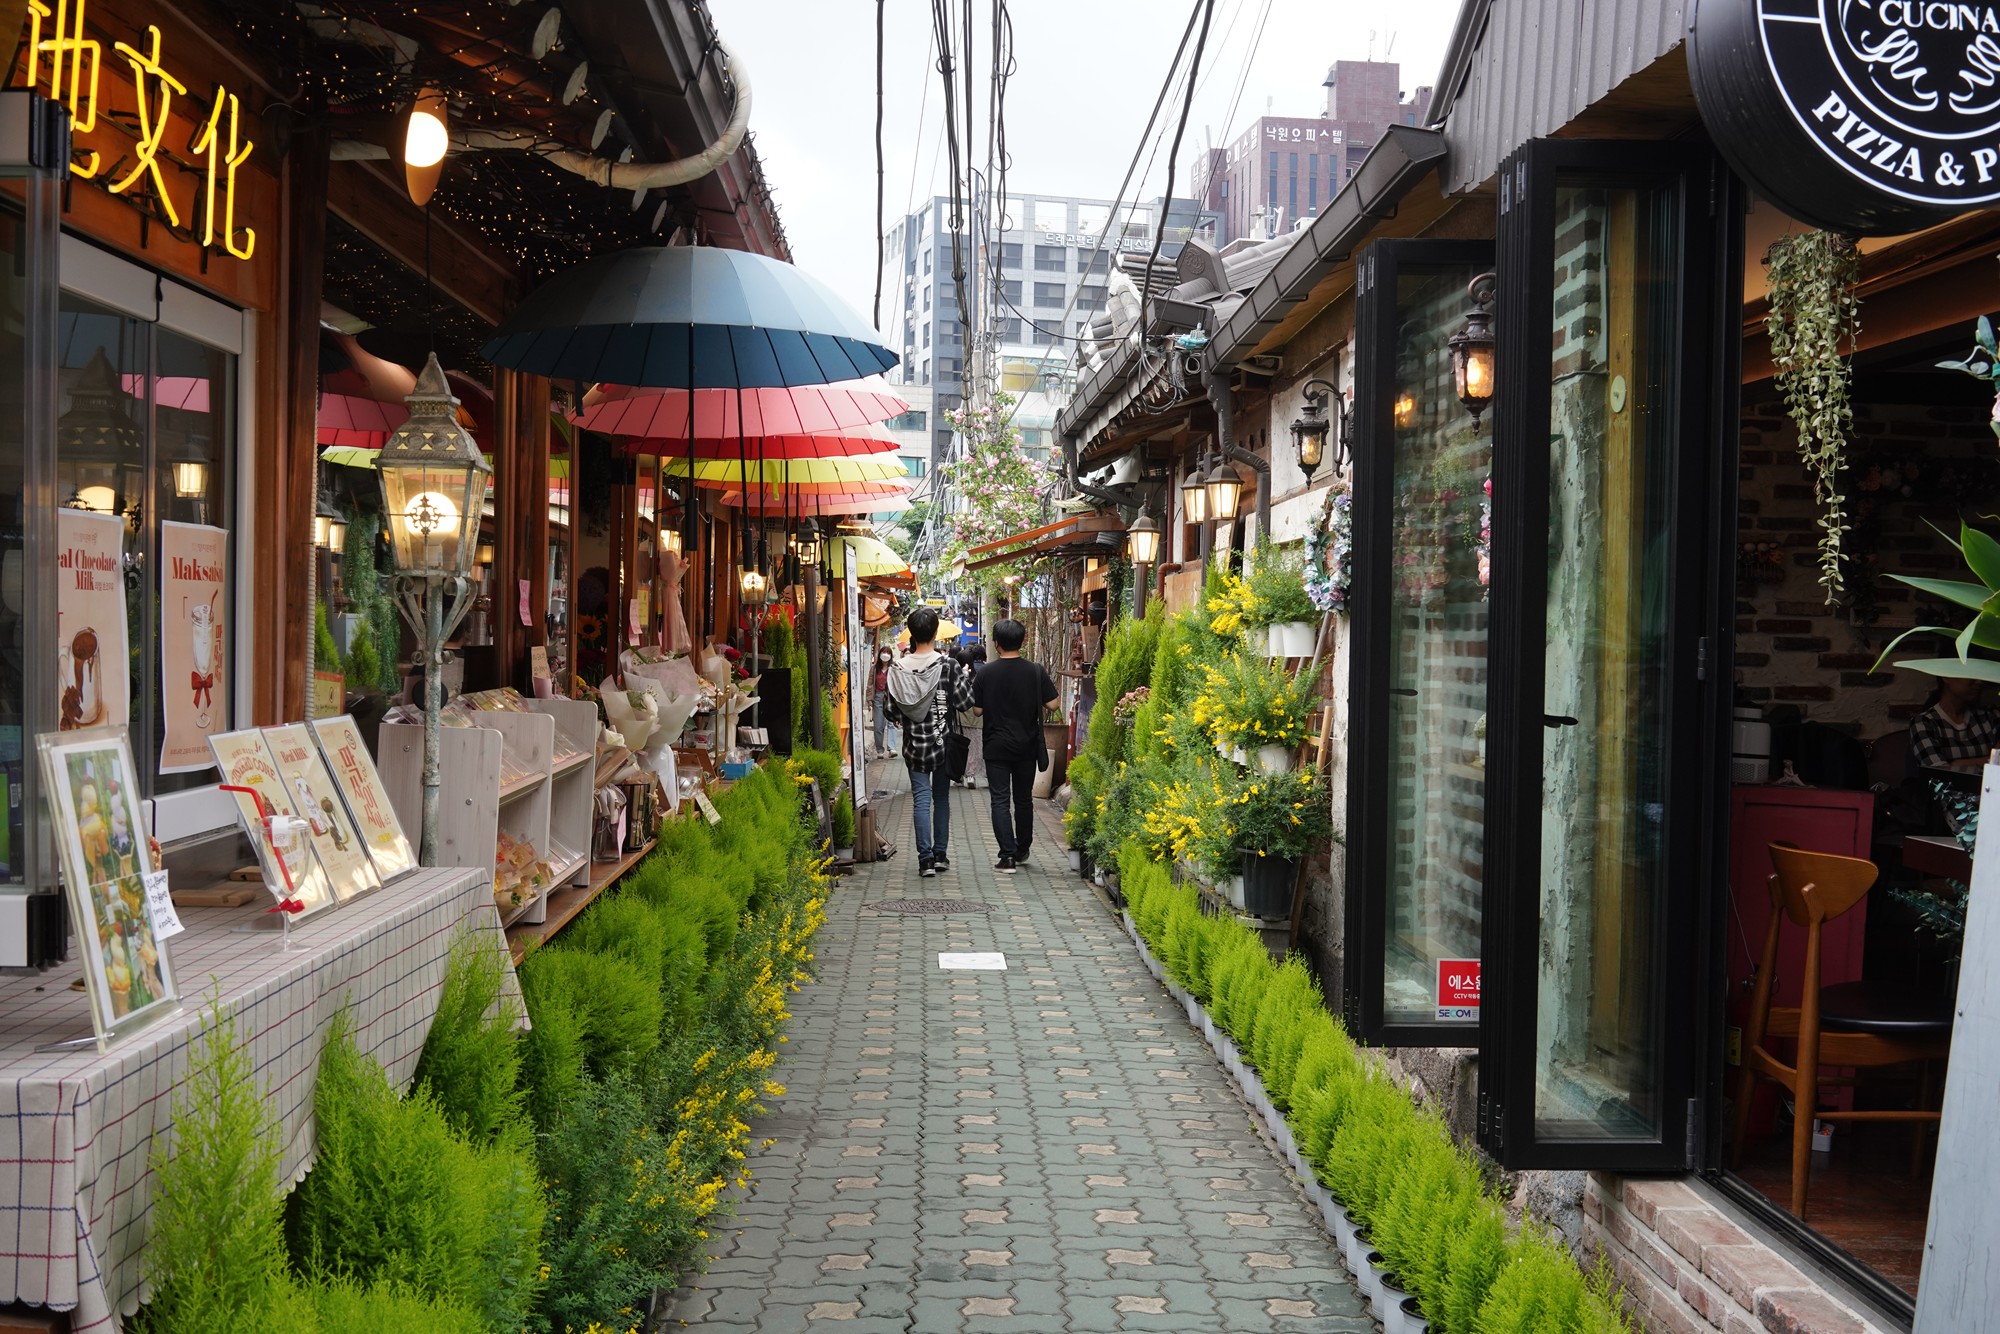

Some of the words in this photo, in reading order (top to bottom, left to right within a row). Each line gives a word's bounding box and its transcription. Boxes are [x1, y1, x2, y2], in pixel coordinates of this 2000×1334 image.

[1879, 0, 2000, 33] CUCINA
[1811, 90, 1925, 183] PIZZA
[1934, 151, 1966, 187] &
[1970, 146, 2000, 183] P
[75, 548, 117, 572] Chocolate
[75, 570, 94, 591] Milk
[1438, 1009, 1471, 1019] SECOM
